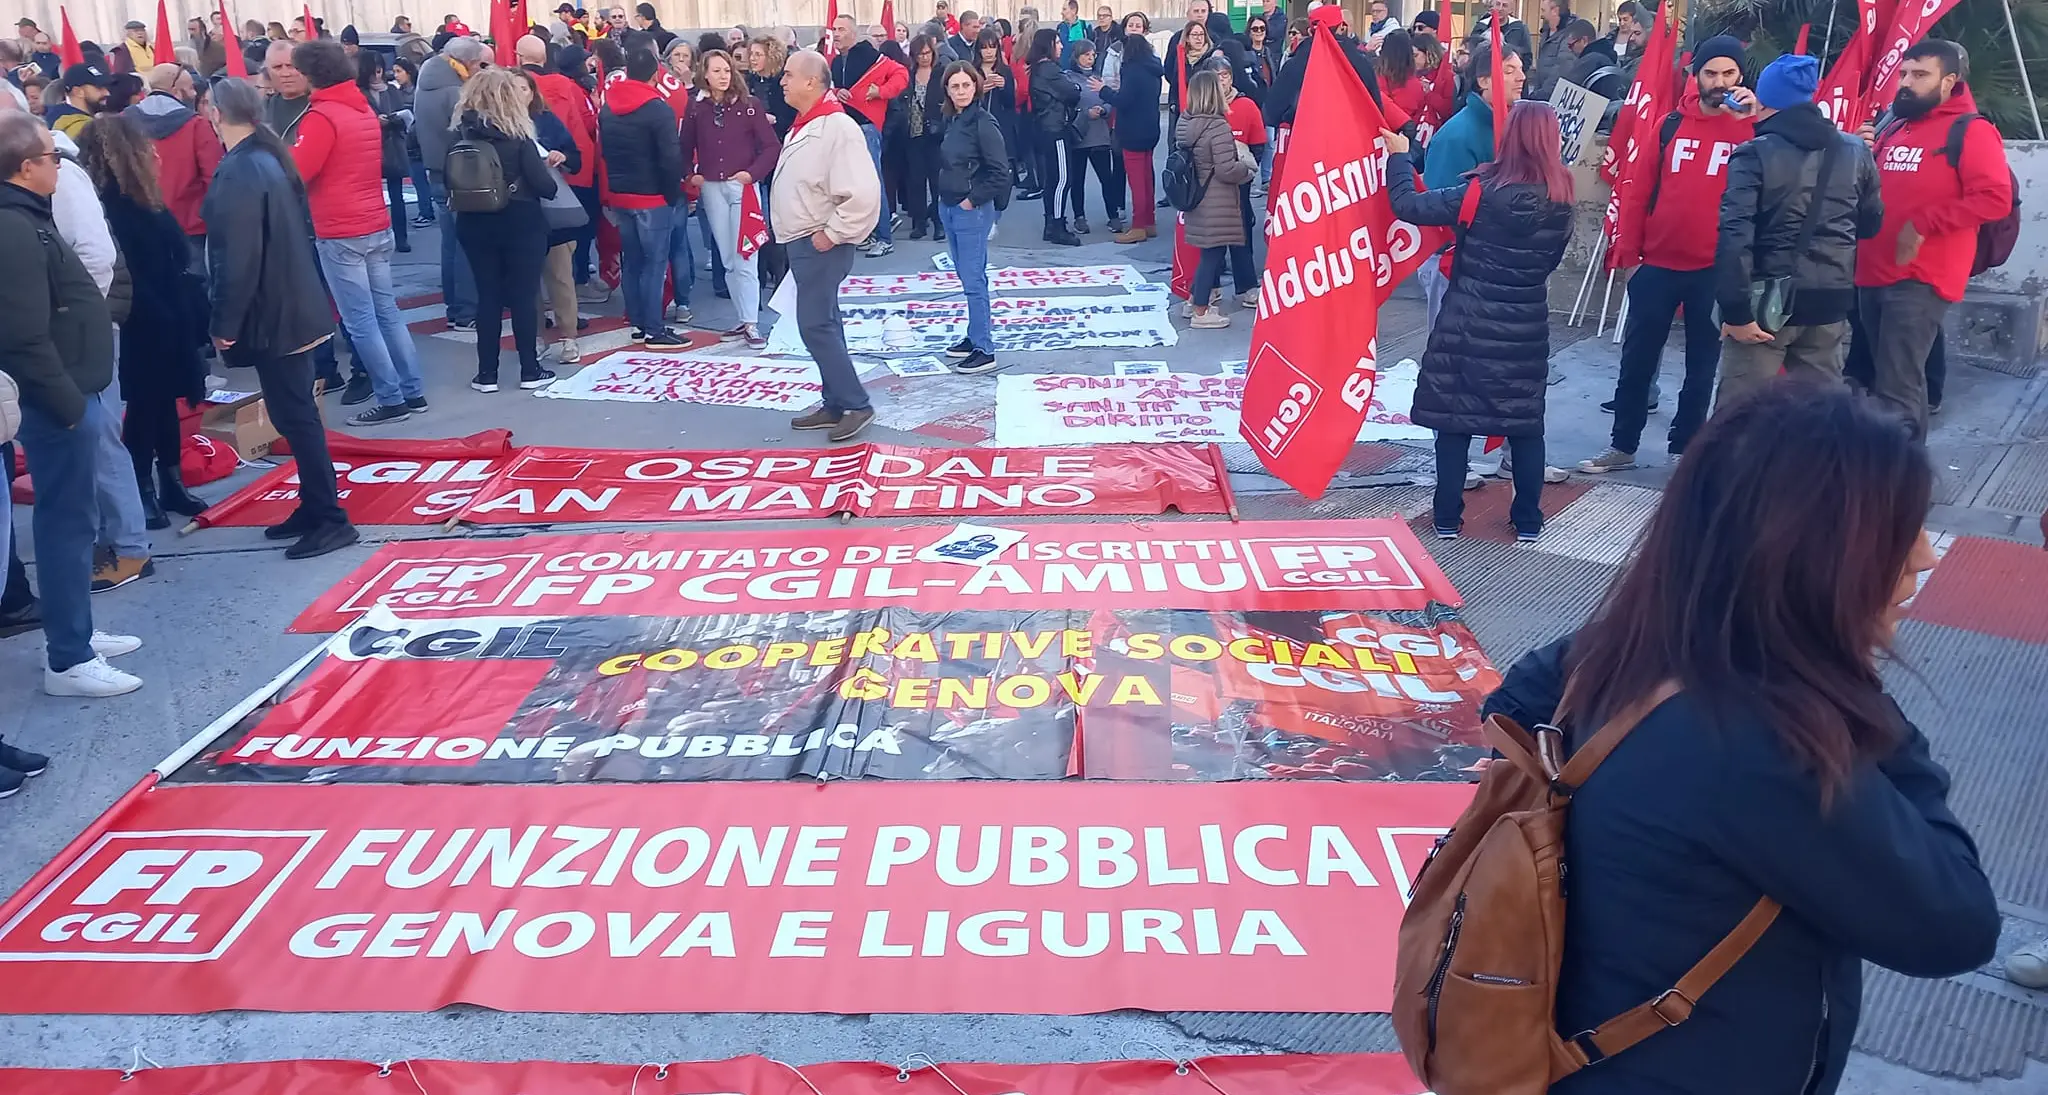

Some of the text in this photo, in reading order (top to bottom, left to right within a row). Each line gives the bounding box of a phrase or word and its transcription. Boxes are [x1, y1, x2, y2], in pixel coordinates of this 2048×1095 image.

[1558, 86, 1586, 115] ALLA
[1556, 112, 1586, 140] RCA
[1883, 162, 1919, 172] GENOVA
[665, 377, 824, 394] LAVORATOR
[1063, 414, 1212, 427] DIRITTO
[624, 451, 1096, 481] OSPEDALE
[412, 479, 1096, 517] SAN MARTINO
[544, 546, 832, 573] COMITATO
[840, 545, 917, 565] DE
[1017, 539, 1236, 561] ISCRITTI
[1268, 545, 1378, 570] FP
[389, 563, 518, 590] FP
[512, 561, 1249, 607] FP CGIL-AMIU
[1283, 569, 1392, 584] CGIL
[374, 590, 480, 605] CGIL
[349, 625, 570, 659] CGIL
[597, 626, 1093, 676] COOPERATIVE
[1126, 632, 1419, 675] SOCIALI
[1336, 627, 1464, 660] CGI
[840, 666, 1163, 708] GENOVA
[1246, 661, 1464, 702] CGIL
[234, 723, 902, 761] FUNZIONE PUBBLICA
[316, 823, 1379, 890] FUNZIONE PUBBLICA
[73, 848, 263, 906] FP
[40, 912, 202, 944] CGIL
[289, 908, 1308, 958] GENOVA E LIGURIA
